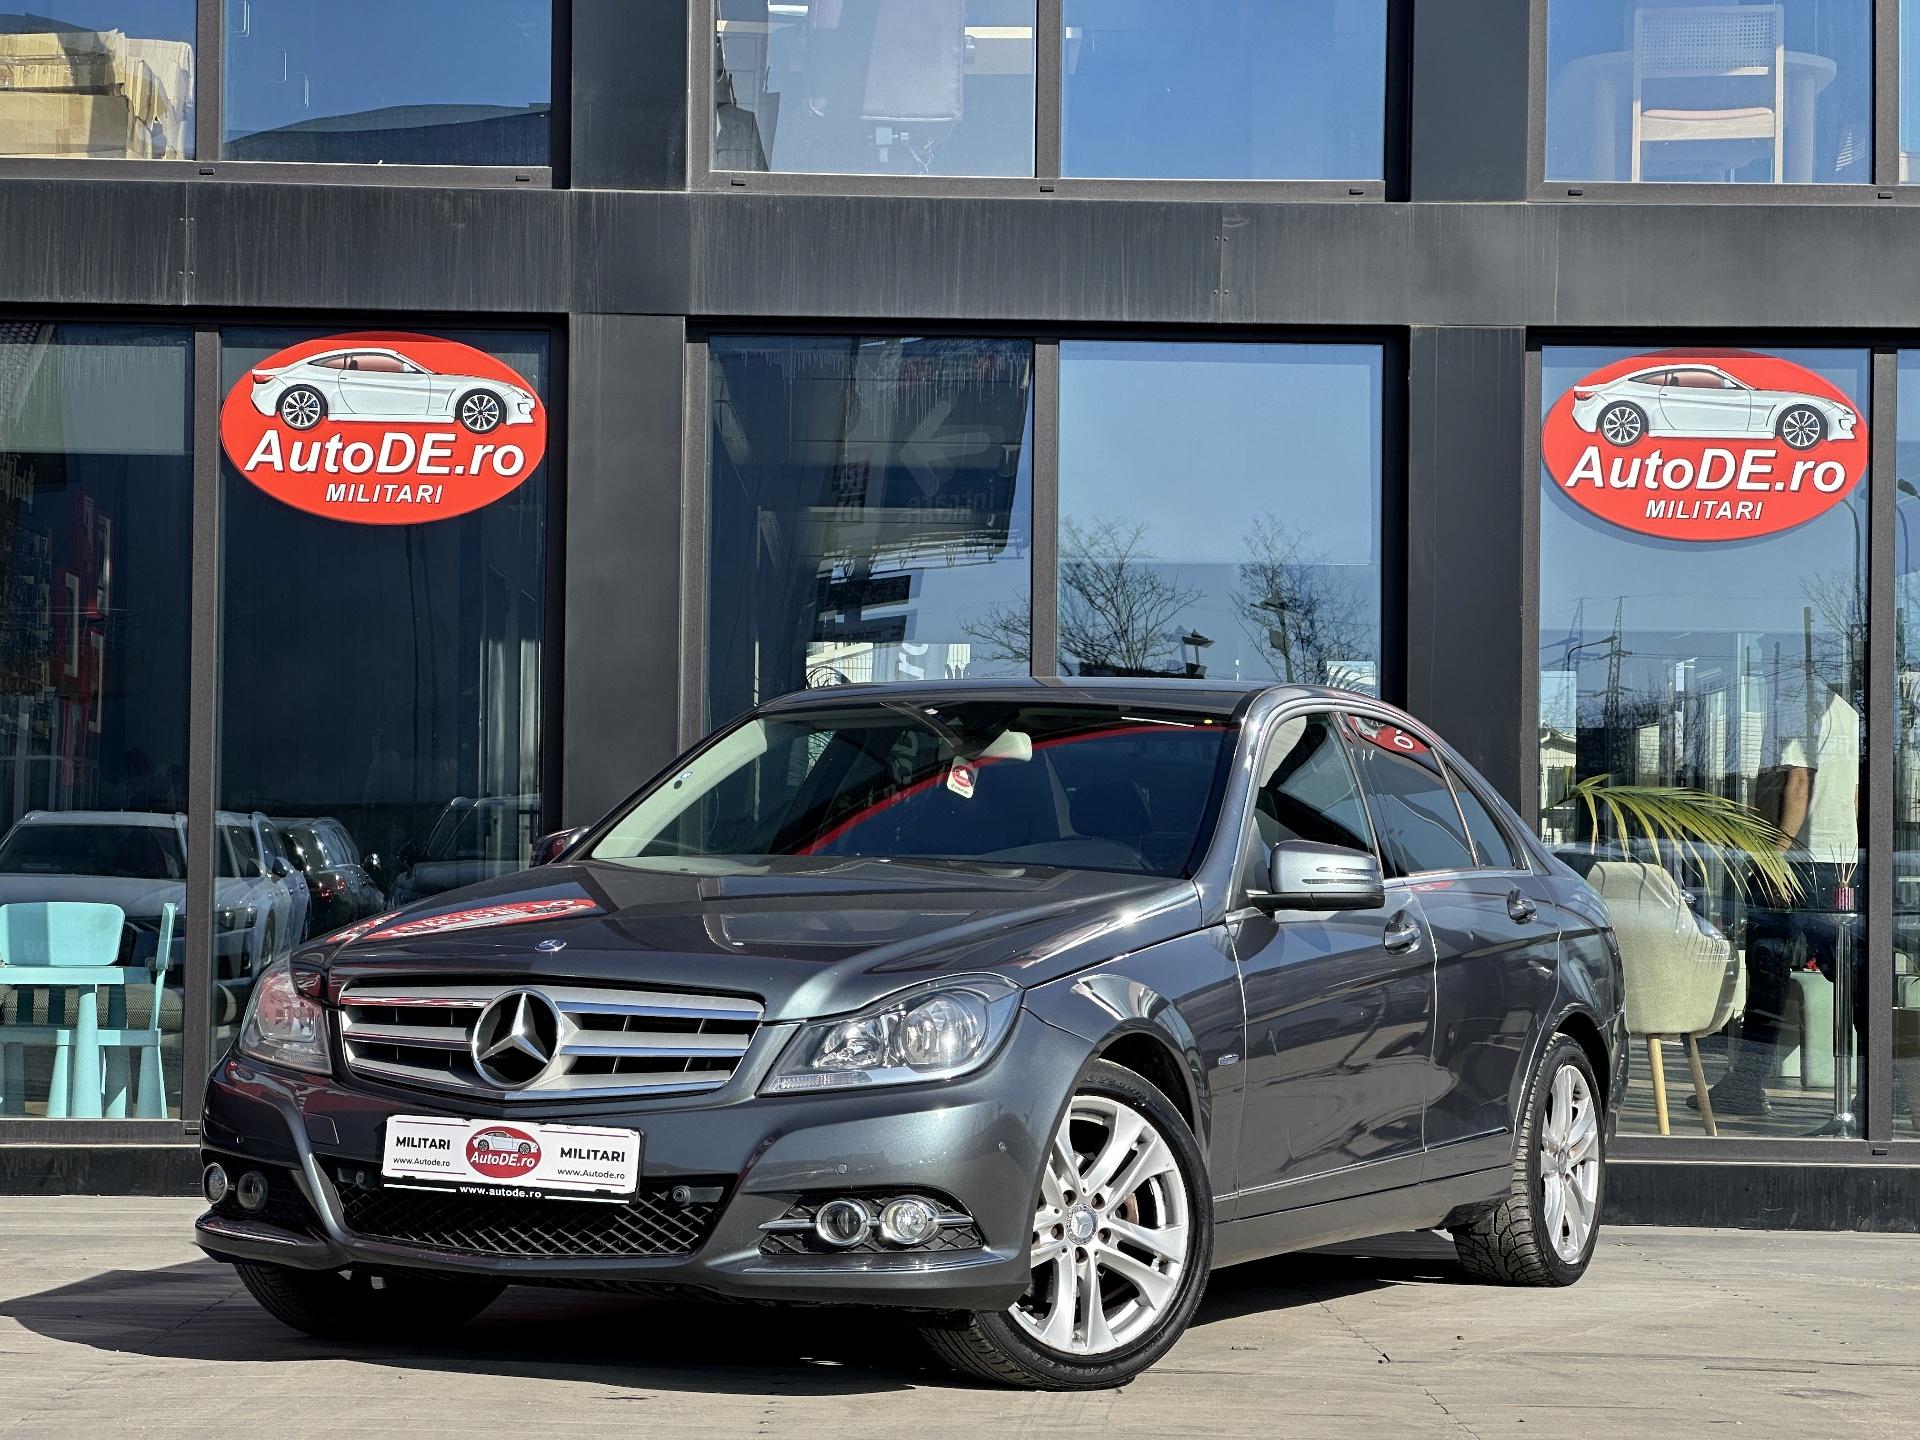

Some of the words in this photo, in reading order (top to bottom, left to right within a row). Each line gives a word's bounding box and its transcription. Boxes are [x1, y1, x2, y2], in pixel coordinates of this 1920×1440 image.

[244, 429, 526, 477] AutoDE.ro
[1565, 445, 1847, 493] AutoDE.ro
[325, 483, 443, 504] MILITARI
[1645, 500, 1763, 520] MILITARI
[395, 1136, 451, 1151] MILITARI
[393, 1156, 451, 1167] www.Autode.ro
[470, 1151, 536, 1169] AutoDE.ro
[559, 1147, 626, 1163] MILITARI
[557, 1168, 626, 1179] www.Autode.ro
[459, 1185, 542, 1199] www.autode.ro
